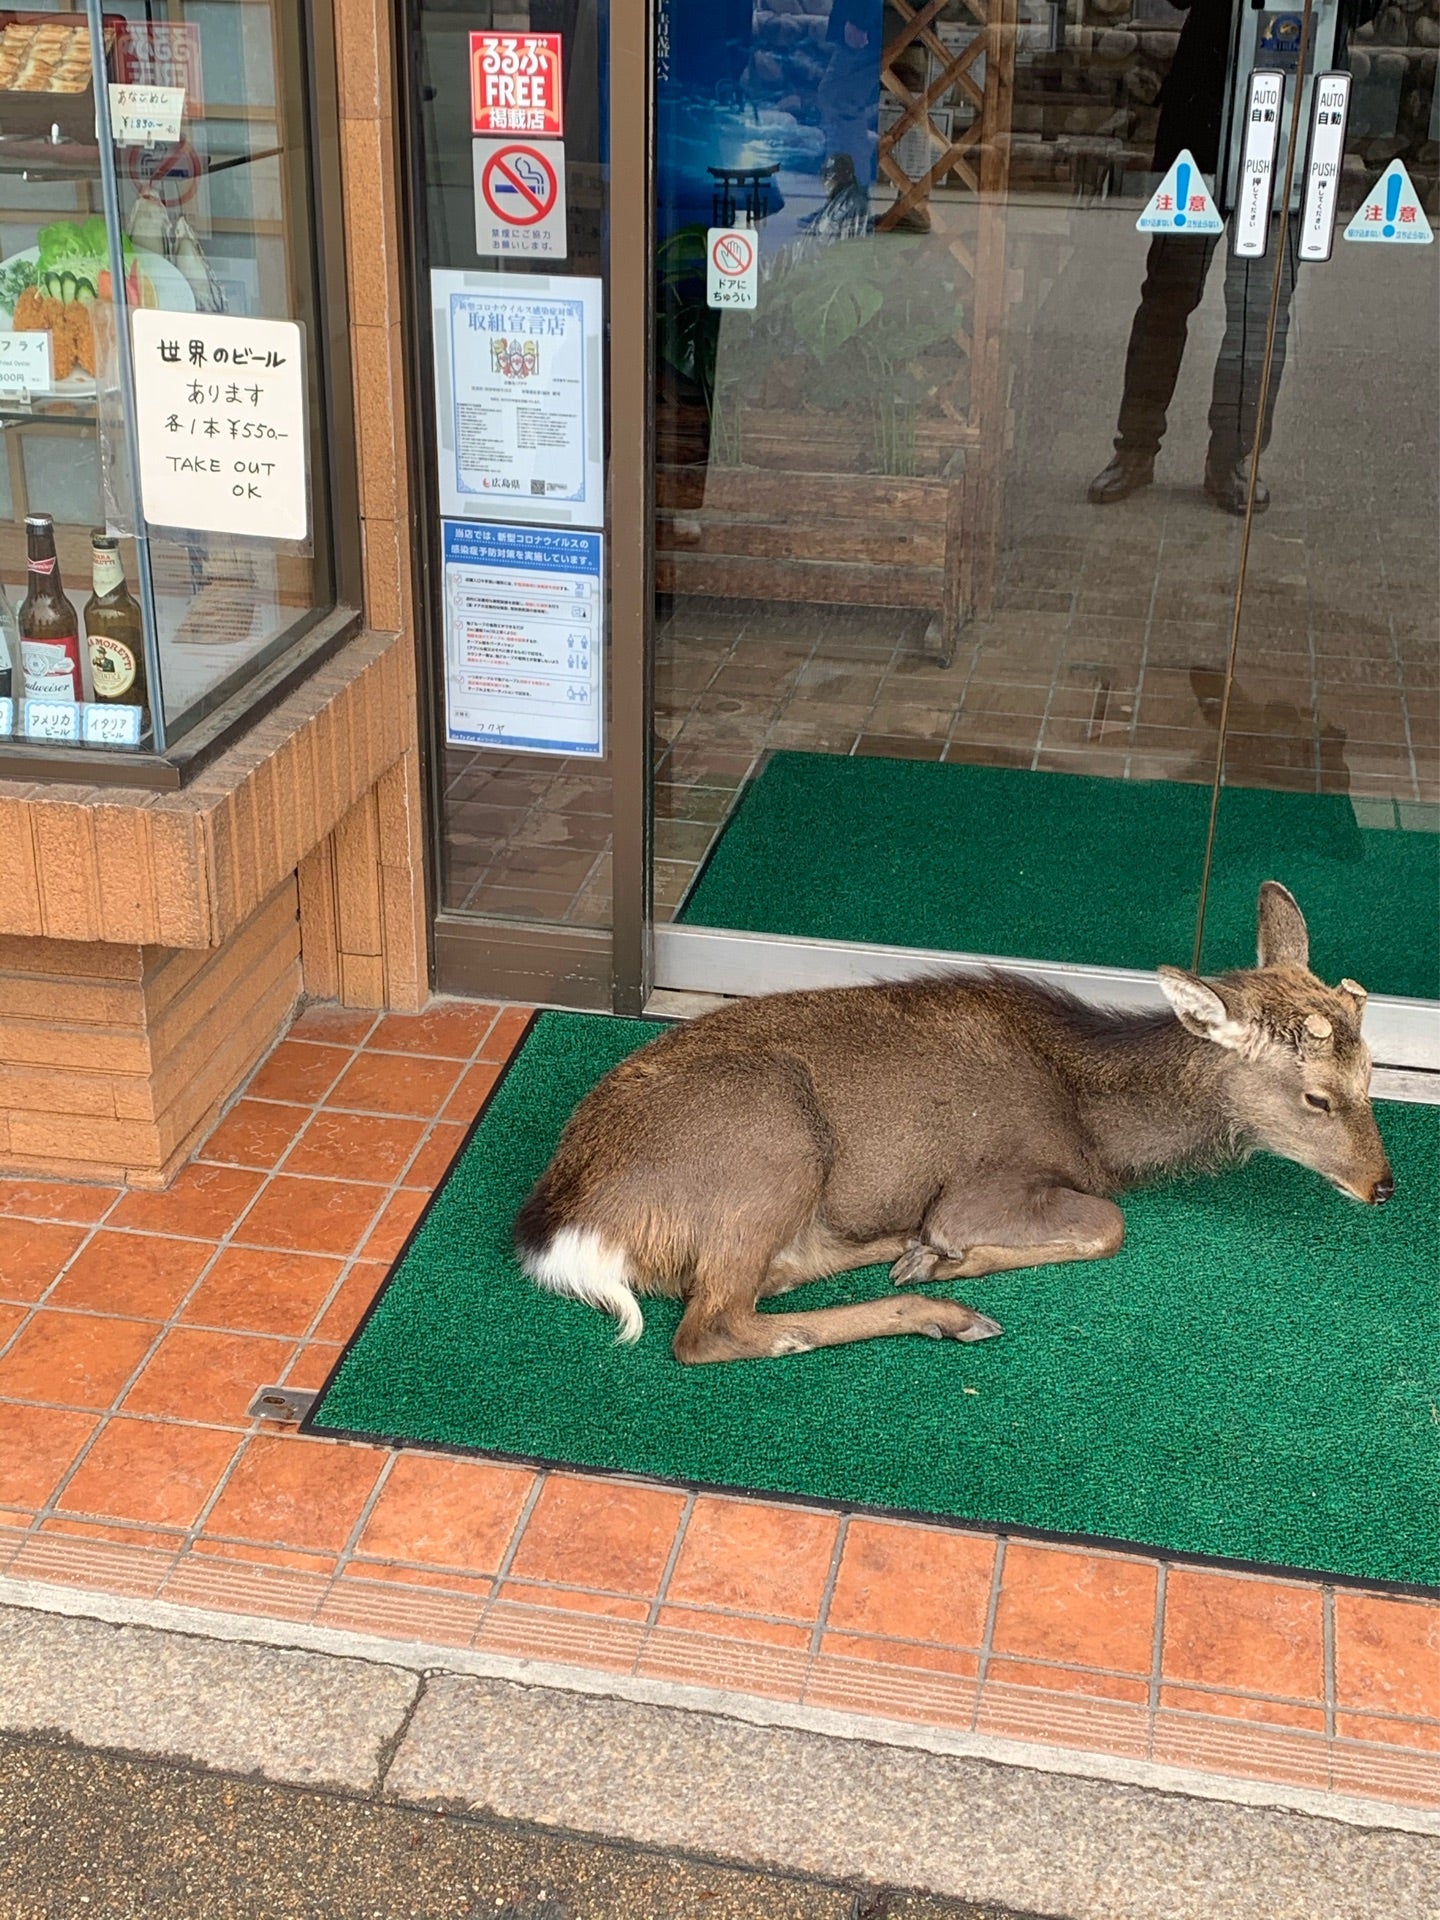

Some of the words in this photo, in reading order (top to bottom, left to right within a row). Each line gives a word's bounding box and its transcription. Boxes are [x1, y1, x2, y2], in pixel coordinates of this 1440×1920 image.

[483, 38, 548, 74] るるぶ
[486, 75, 546, 107] FREE
[1253, 89, 1277, 105] AUTO
[1320, 92, 1344, 107] AUTO
[489, 108, 545, 130] 掲載店
[1251, 109, 1275, 123] 自動
[1317, 111, 1342, 126] 自動
[1246, 159, 1270, 174] PUSH
[1312, 162, 1336, 177] PUSH
[491, 228, 551, 240] 禁煙にご協力
[718, 278, 747, 290] ドアに
[713, 291, 751, 304] ちゅうい
[468, 311, 566, 336] 取組宣言店
[157, 338, 287, 369] 世界のビール
[187, 378, 264, 407] あります
[165, 456, 222, 473] TAKE
[233, 460, 276, 476] OUT
[232, 483, 262, 498] OK
[492, 478, 520, 490] 広島県
[31, 714, 71, 727] アメリカ
[91, 718, 127, 730] イタリア
[45, 727, 71, 736] ビール
